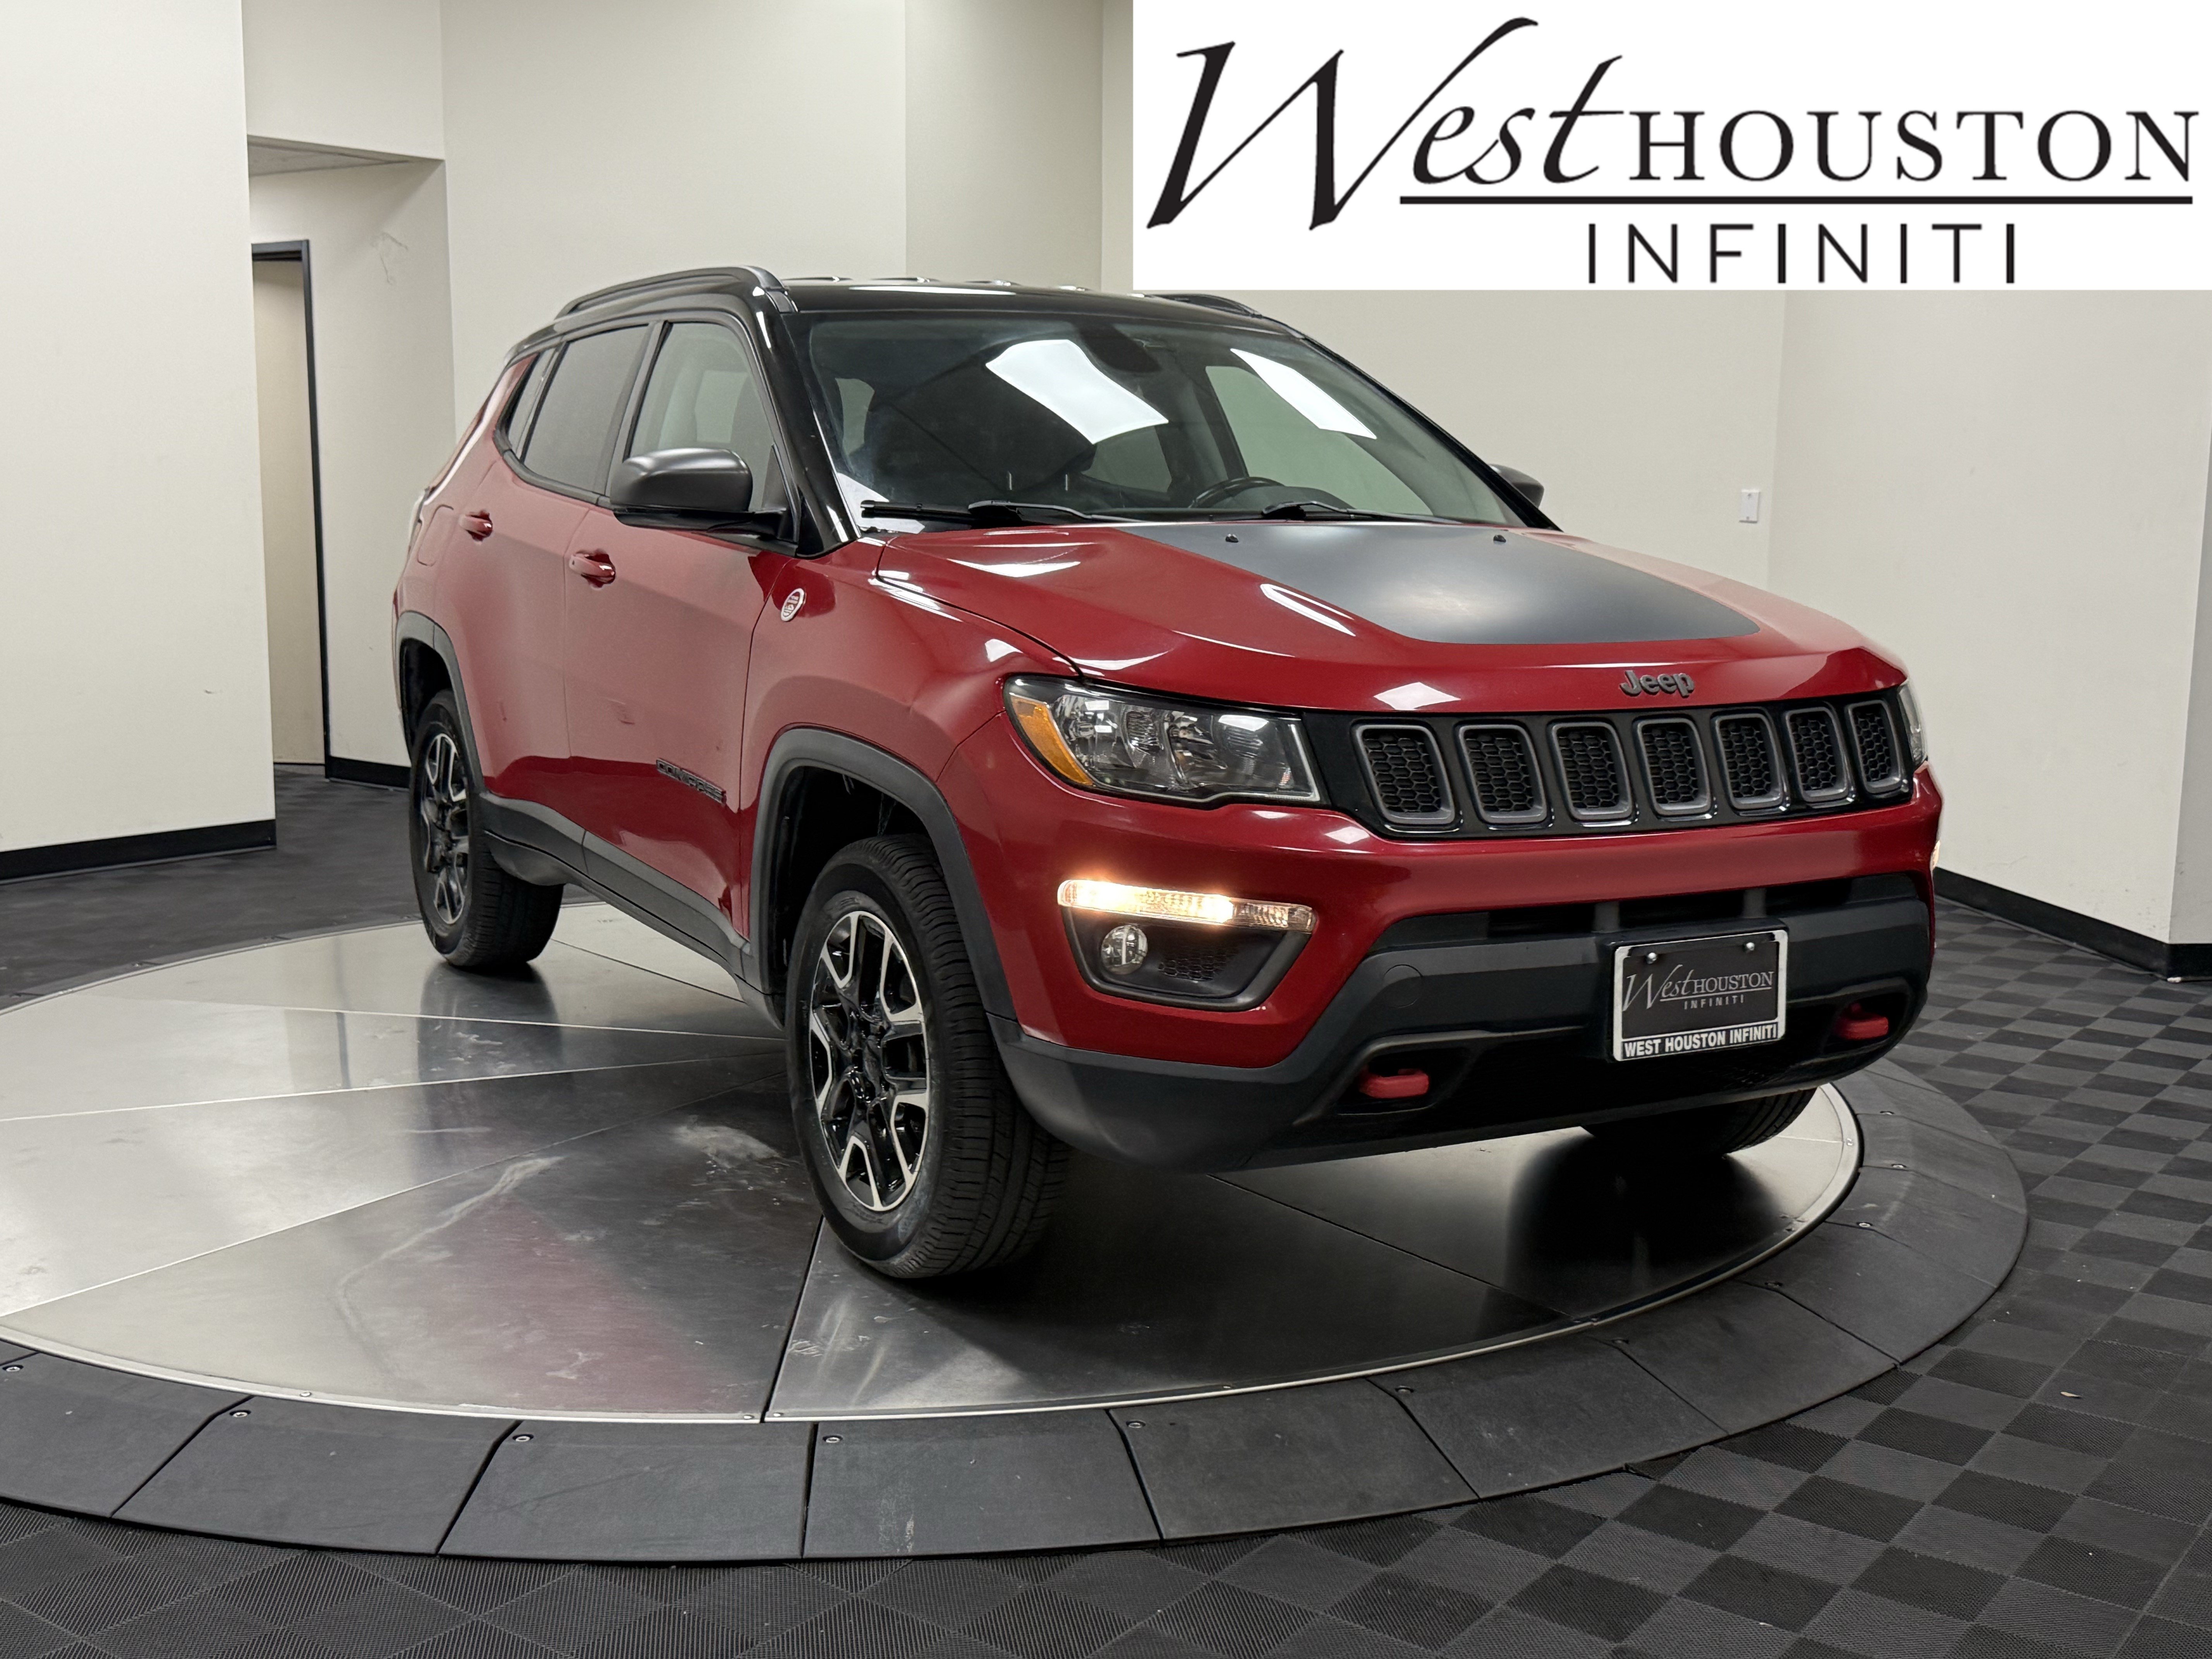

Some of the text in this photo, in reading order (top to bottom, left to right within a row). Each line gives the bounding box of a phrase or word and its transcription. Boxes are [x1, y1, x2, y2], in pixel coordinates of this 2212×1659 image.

[1620, 670, 1695, 697] Jeep
[1684, 994, 1744, 1010] INFINITI
[1625, 1024, 1777, 1057] WEST HOUSTON INFINITI
